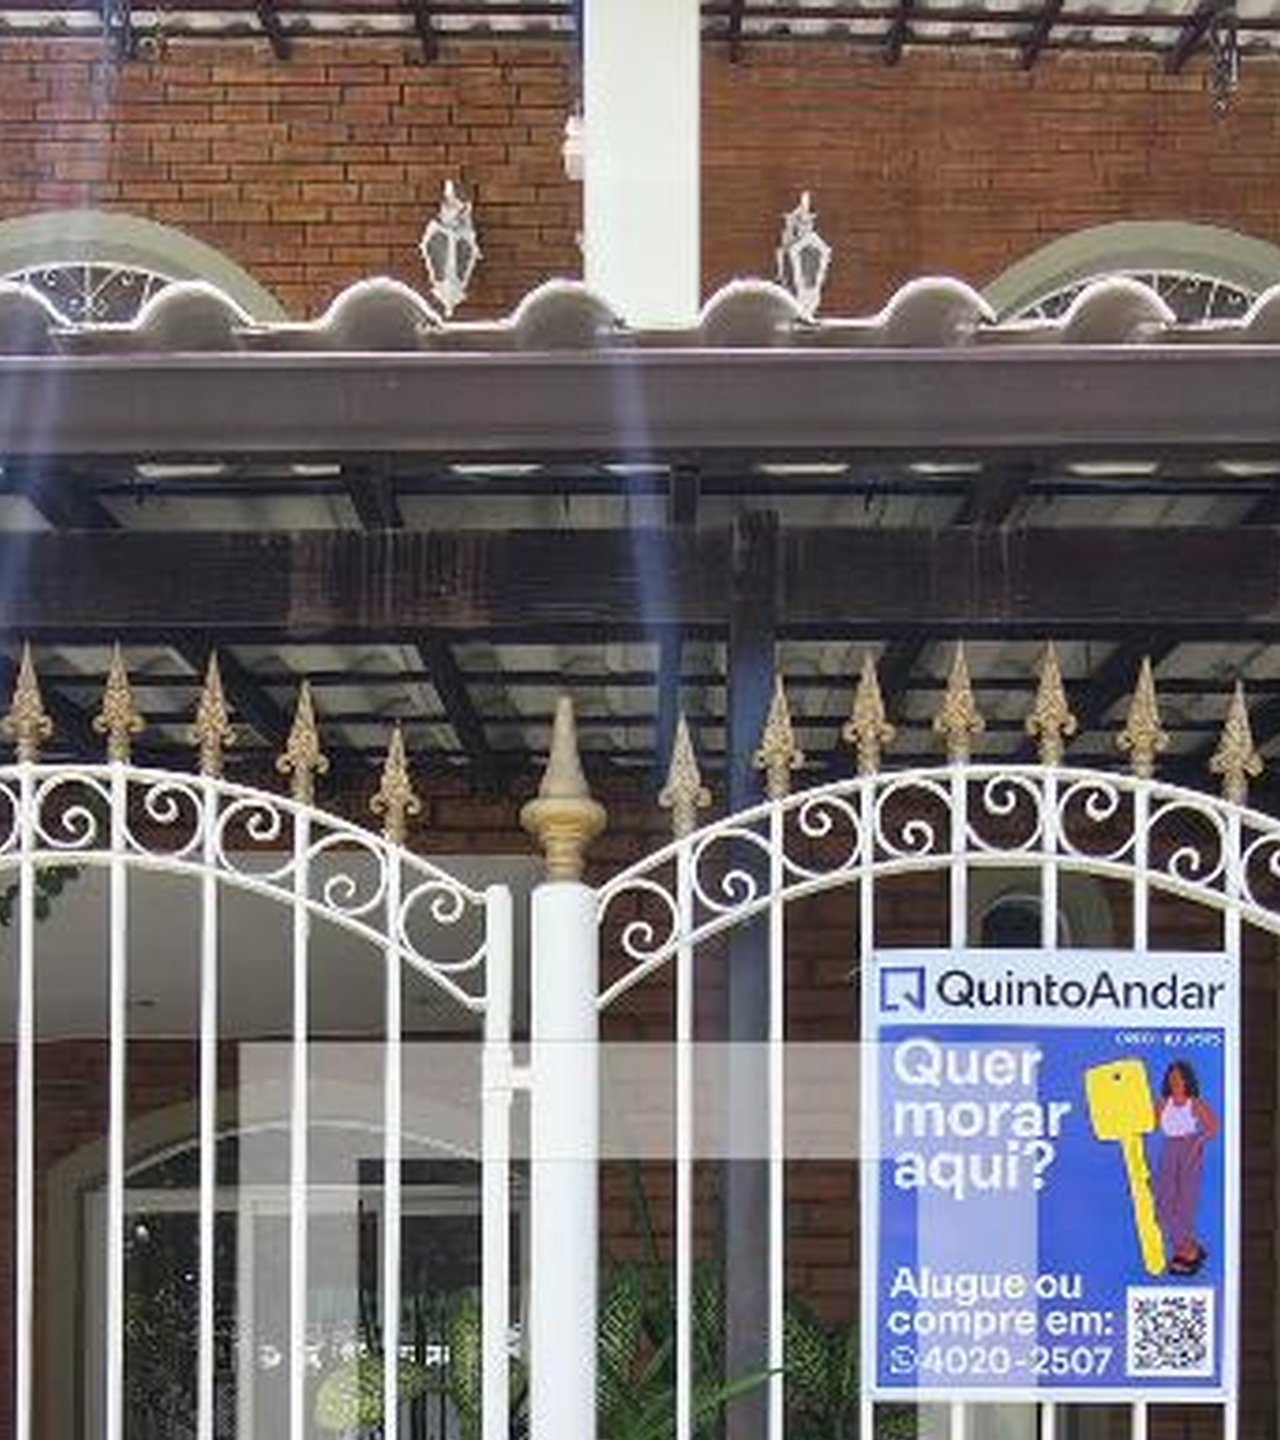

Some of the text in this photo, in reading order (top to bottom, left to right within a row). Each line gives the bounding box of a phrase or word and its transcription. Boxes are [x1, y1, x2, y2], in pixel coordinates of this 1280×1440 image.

[936, 970, 1224, 1010] QuintoAndar
[894, 1039, 1042, 1087] Quer
[893, 1101, 1071, 1138] morar
[894, 1143, 1054, 1200] aqui?
[890, 1267, 1082, 1306] Alugue ou
[888, 1310, 1114, 1341] compre em:
